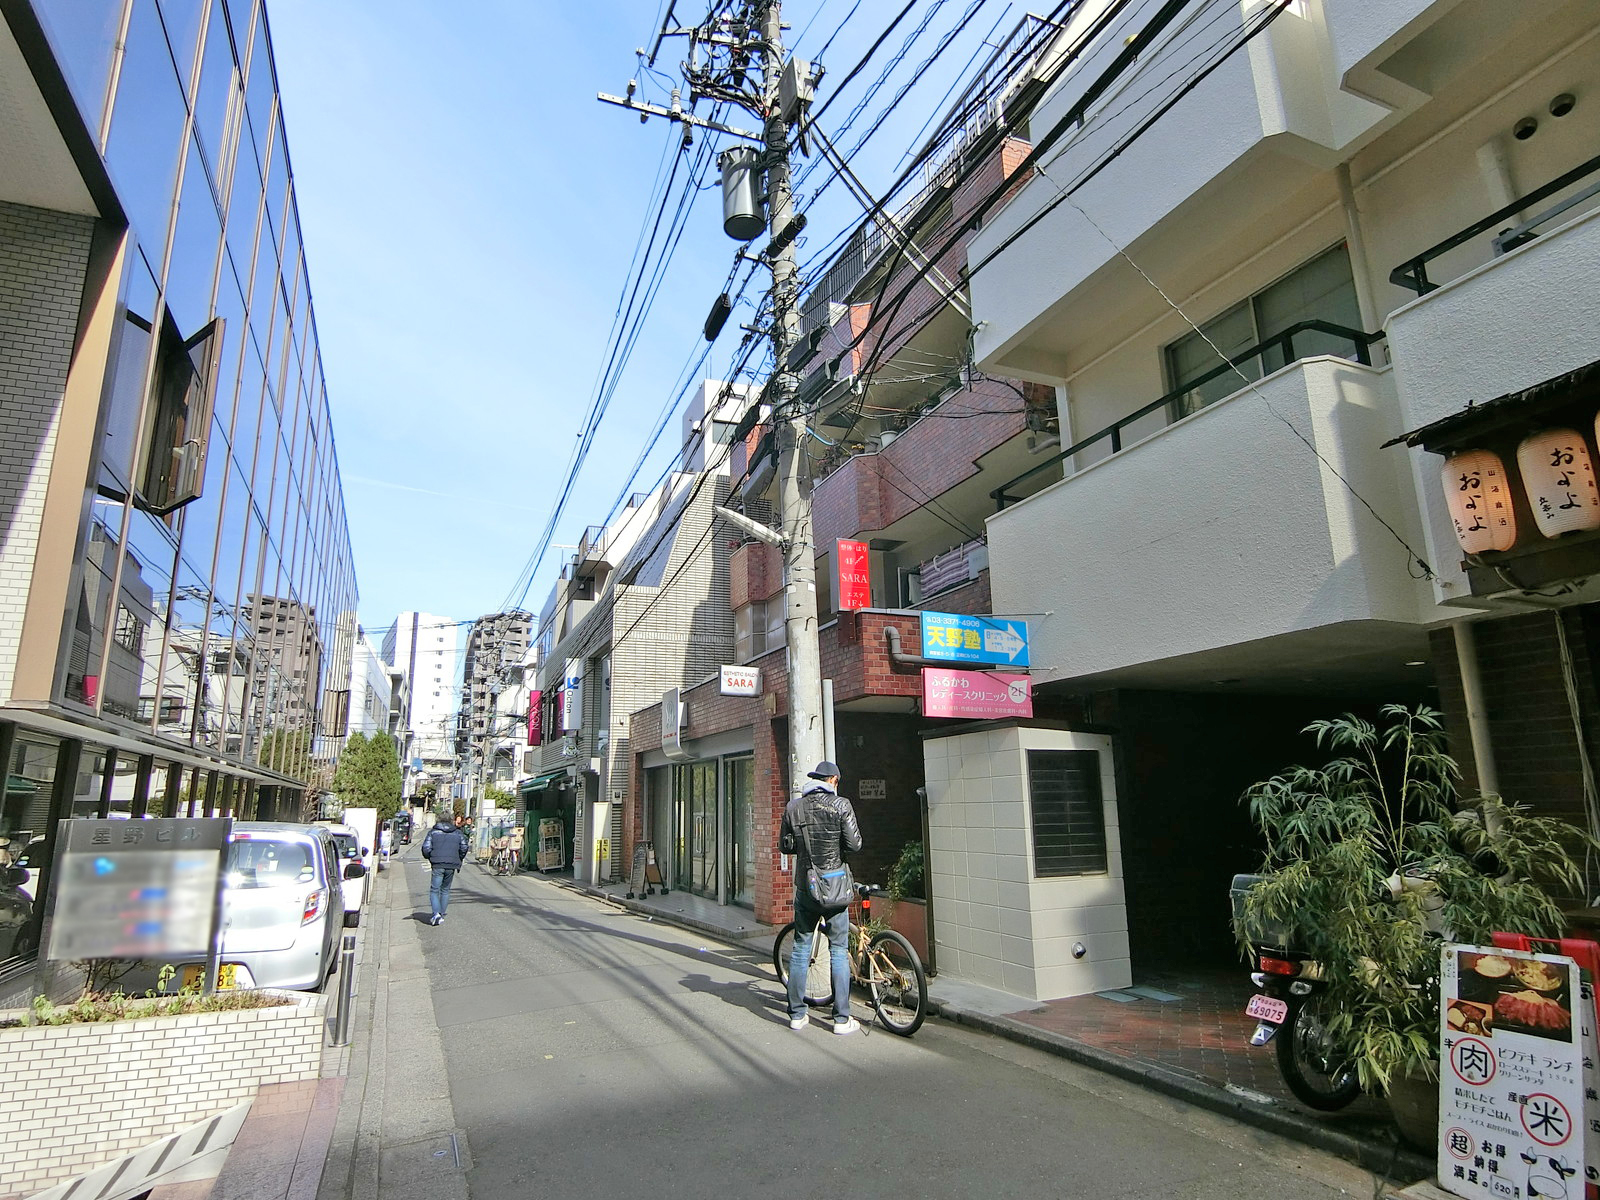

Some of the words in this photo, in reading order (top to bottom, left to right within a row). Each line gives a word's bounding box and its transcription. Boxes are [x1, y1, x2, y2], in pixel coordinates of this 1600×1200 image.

[1550, 446, 1582, 510] およよ
[1459, 471, 1488, 532] およよ
[841, 572, 868, 584] SARA
[847, 599, 858, 607] 1F
[926, 625, 982, 650] 天野塾
[727, 677, 754, 689] SARA
[931, 676, 970, 689] ふるかわ
[566, 690, 574, 714] Octon
[931, 688, 1007, 703] レディースクリニック
[1011, 687, 1023, 697] 2F
[91, 826, 201, 845] 星野ビル
[1443, 1037, 1455, 1049] 牛
[1459, 1044, 1488, 1079] 肉
[1542, 1056, 1574, 1072] ランチ
[1507, 1091, 1529, 1106] 産直
[1453, 1099, 1513, 1123] モチモチごはん
[1529, 1101, 1564, 1138] 米
[1450, 1132, 1468, 1154] 超
[1481, 1140, 1507, 1159] お得
[1474, 1154, 1499, 1174] 納得
